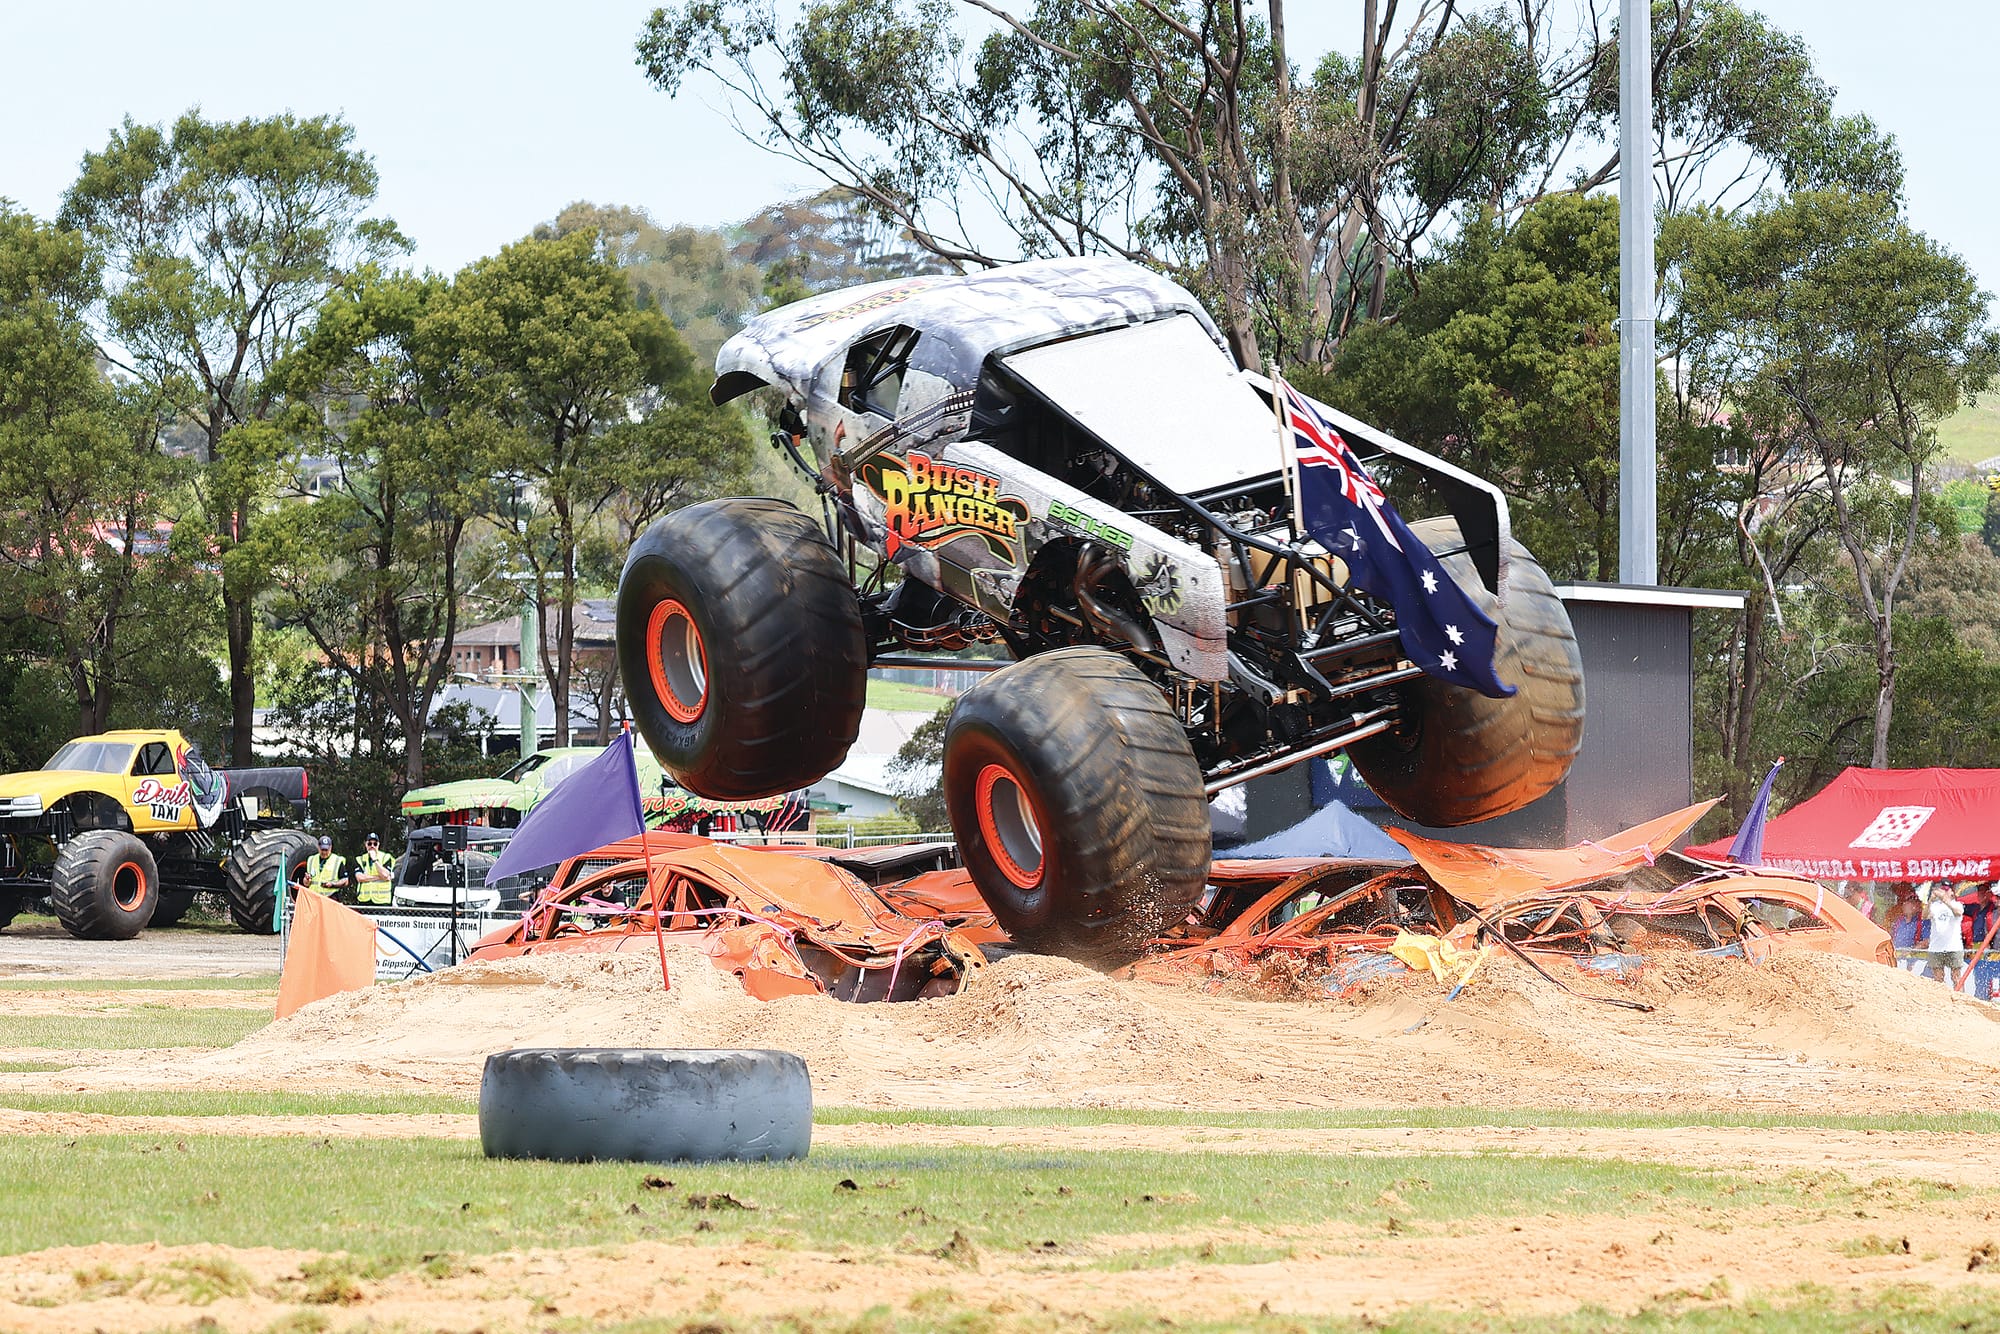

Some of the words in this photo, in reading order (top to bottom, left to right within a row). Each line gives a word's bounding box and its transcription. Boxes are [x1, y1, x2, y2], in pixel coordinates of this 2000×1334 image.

[908, 452, 1000, 505] BUSH
[882, 468, 1017, 560] RANGER
[133, 779, 190, 806] Devils
[150, 803, 179, 821] TAXI
[641, 796, 688, 812] TORS
[697, 795, 786, 815] REVENGE
[1861, 860, 1903, 878] FIRE
[1907, 858, 1991, 878] BRIGADE
[413, 920, 436, 929] Street
[438, 921, 478, 931] LEOGATHA
